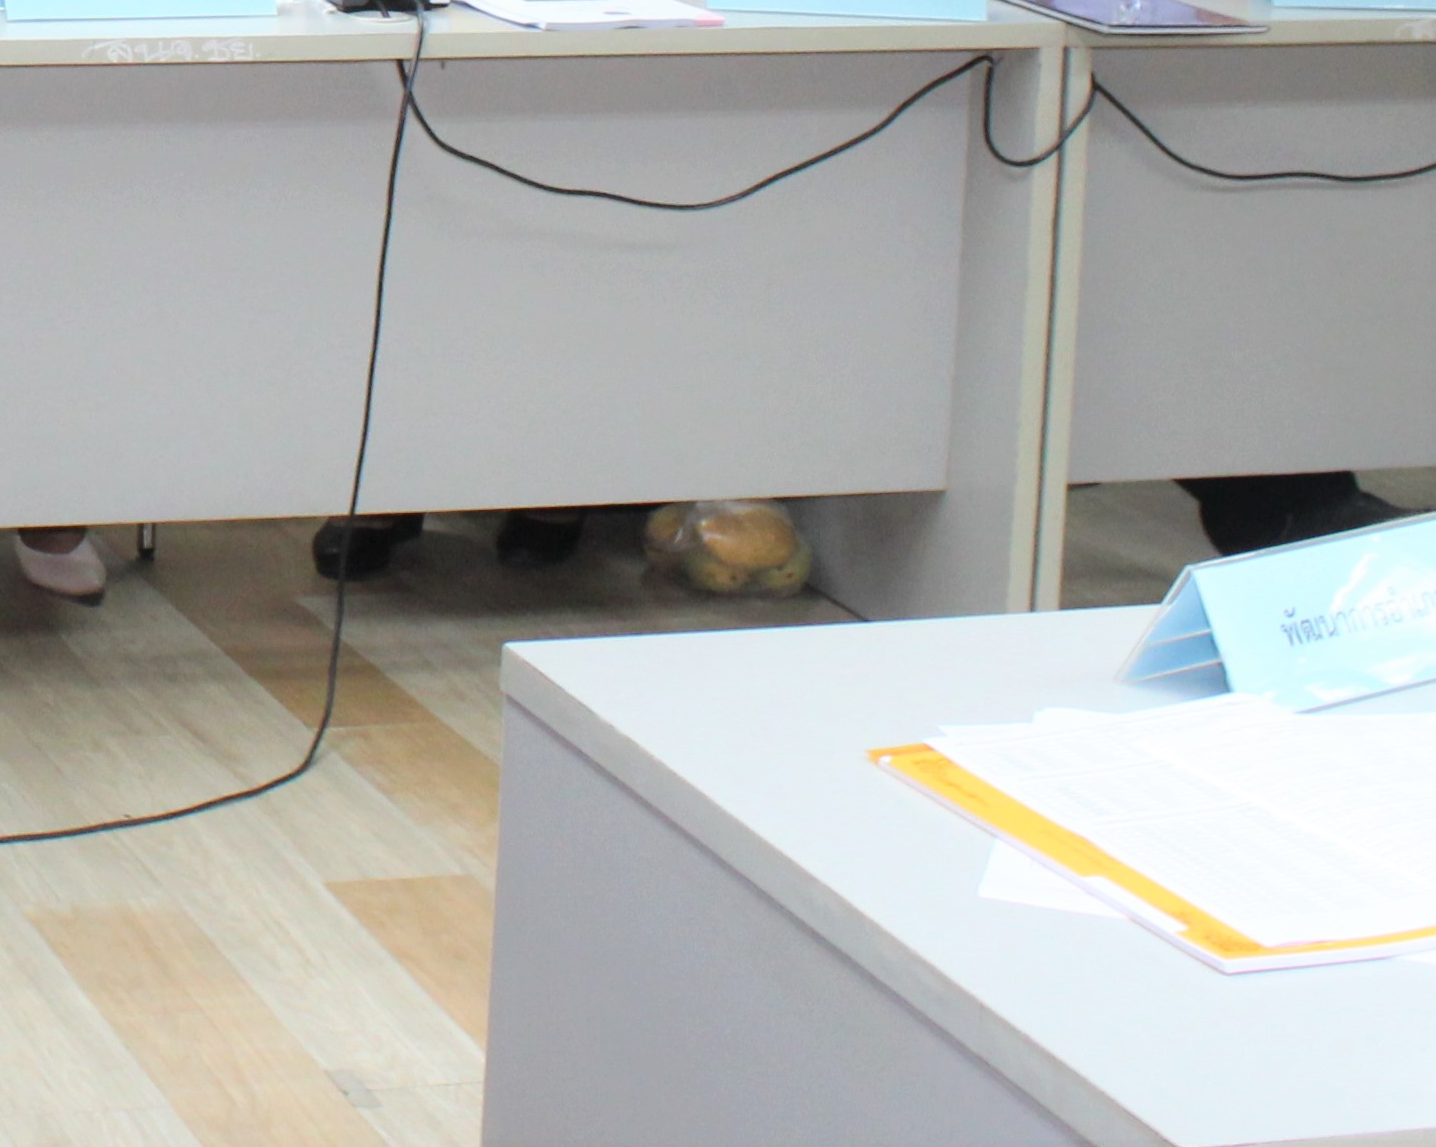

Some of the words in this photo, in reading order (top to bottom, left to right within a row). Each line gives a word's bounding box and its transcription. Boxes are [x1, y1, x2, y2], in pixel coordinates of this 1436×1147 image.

[1280, 585, 1436, 647] พัฒนาการอำเภ
